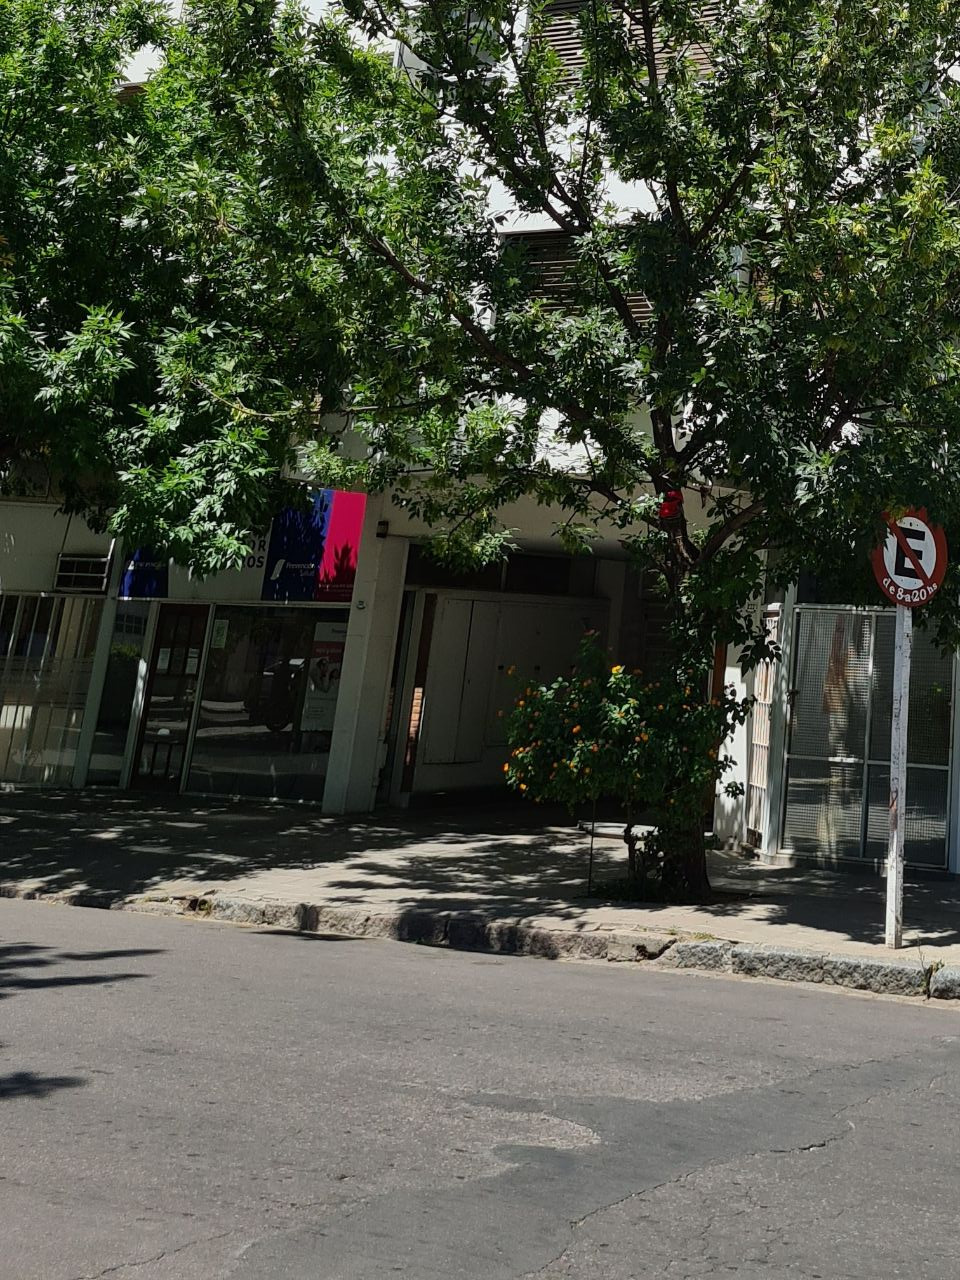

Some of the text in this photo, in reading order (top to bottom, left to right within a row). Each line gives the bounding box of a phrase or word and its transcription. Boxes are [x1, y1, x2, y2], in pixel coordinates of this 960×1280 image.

[894, 526, 926, 580] E
[882, 577, 896, 594] de
[912, 590, 927, 602] 20
